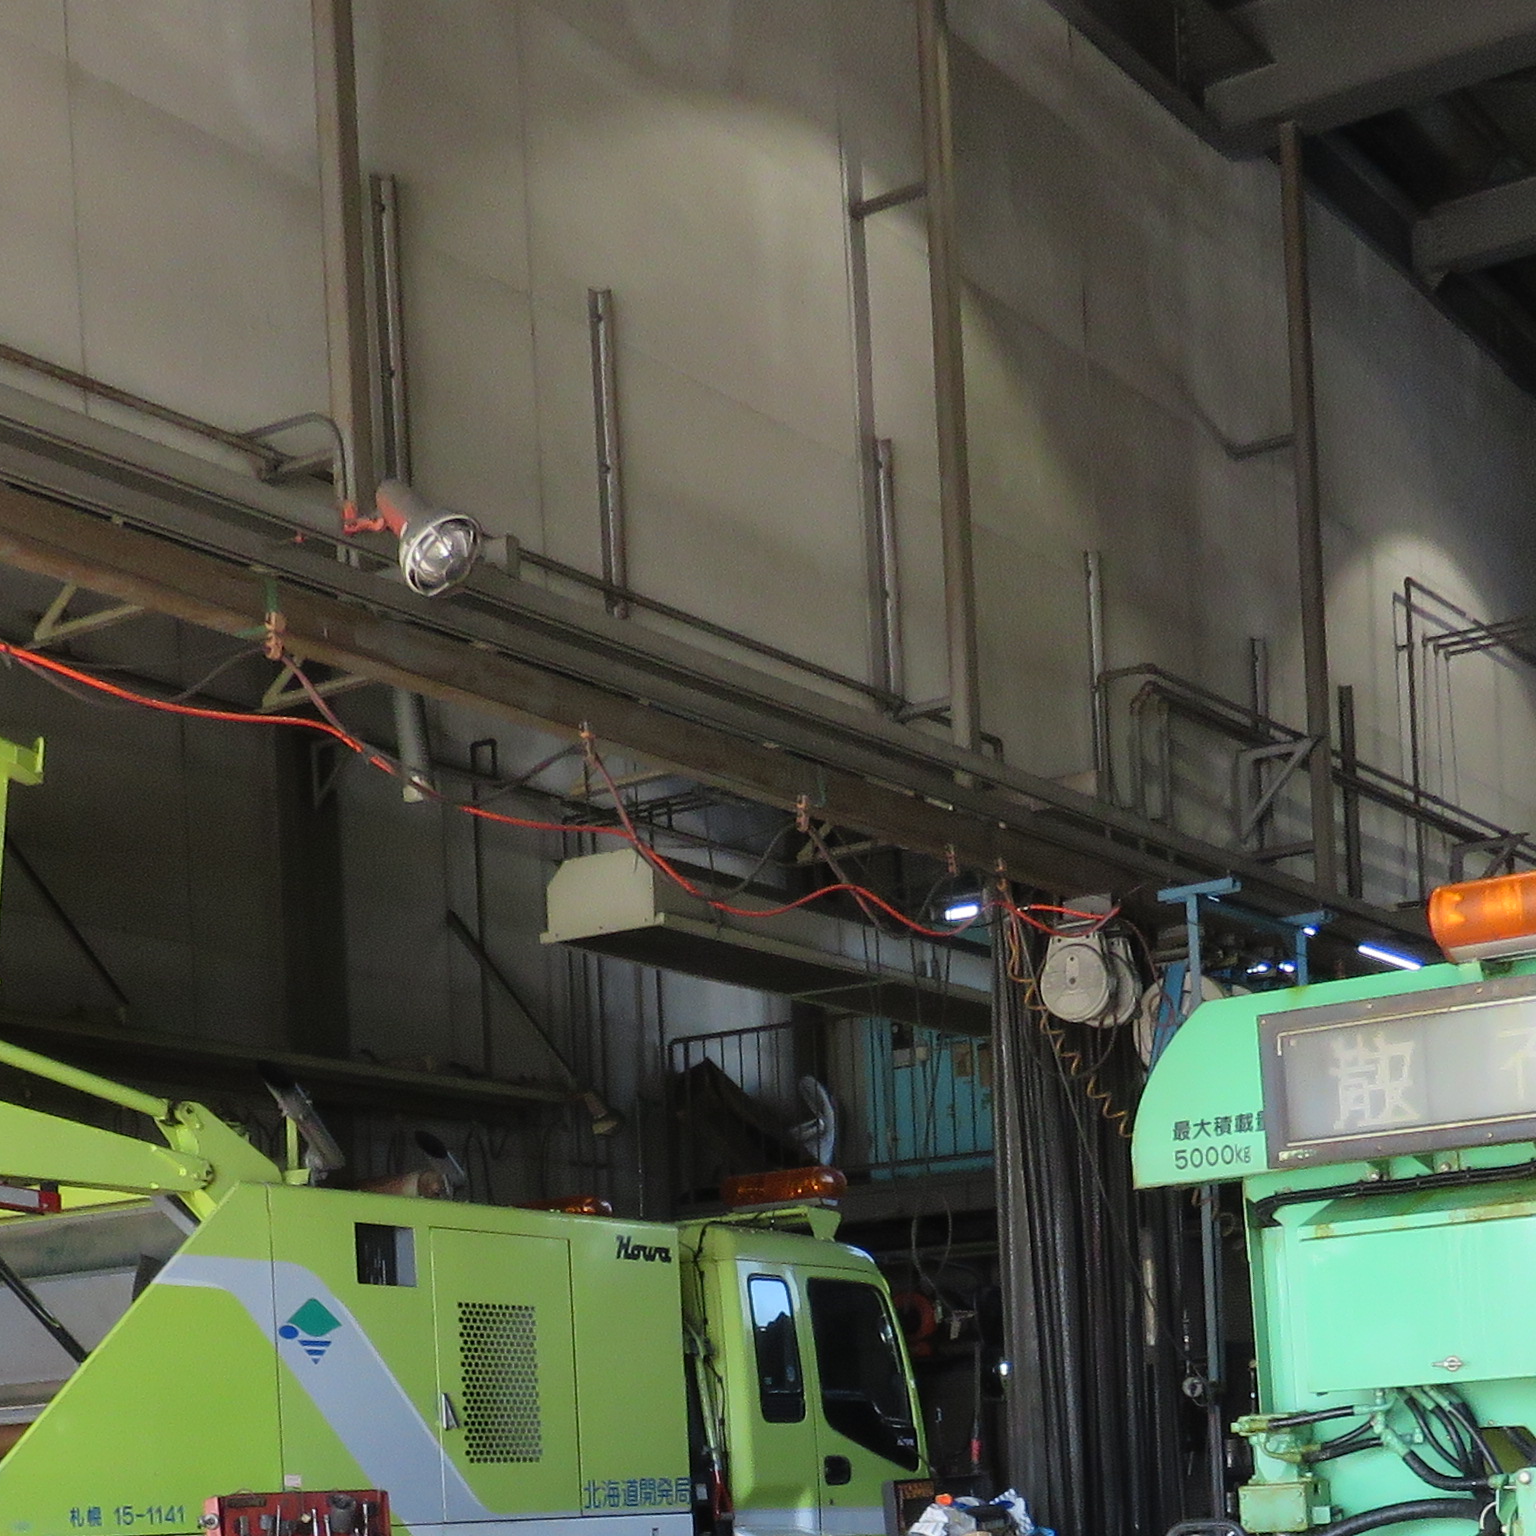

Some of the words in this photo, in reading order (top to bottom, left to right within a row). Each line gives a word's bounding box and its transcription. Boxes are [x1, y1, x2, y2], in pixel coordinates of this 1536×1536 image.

[616, 1234, 672, 1263] Howa
[584, 1476, 692, 1509] 北海道開発局
[70, 1506, 103, 1527] 札幌
[114, 1504, 185, 1526] 15-1141
